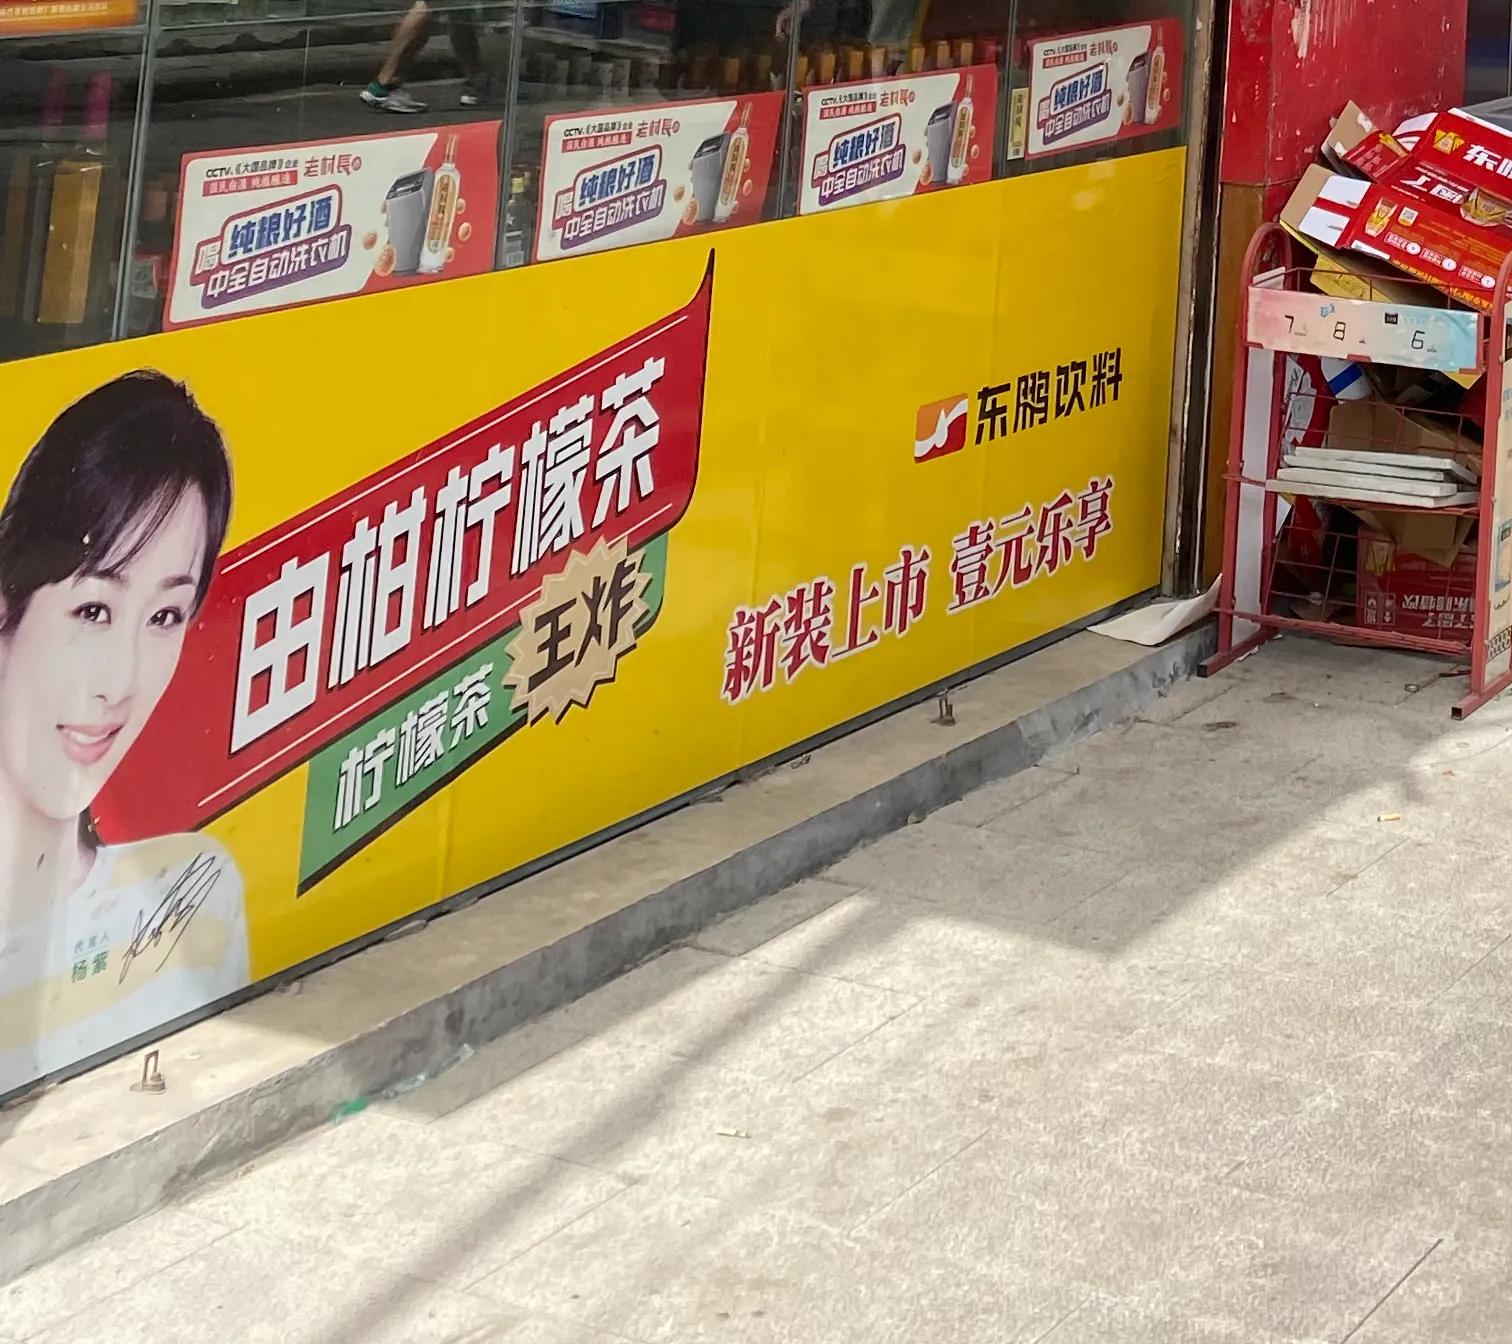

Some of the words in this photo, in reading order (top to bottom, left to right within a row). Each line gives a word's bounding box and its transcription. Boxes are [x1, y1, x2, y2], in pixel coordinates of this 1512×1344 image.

[205, 231, 349, 299] 中全自动洗衣机
[974, 347, 1122, 446] 东鹏饮料
[228, 356, 666, 756] 由柑柠檬茶
[526, 559, 638, 692] 王炸
[720, 545, 932, 704] 新装上市
[946, 473, 1115, 616] 壹元乐享
[333, 661, 494, 831] 柠檬茶
